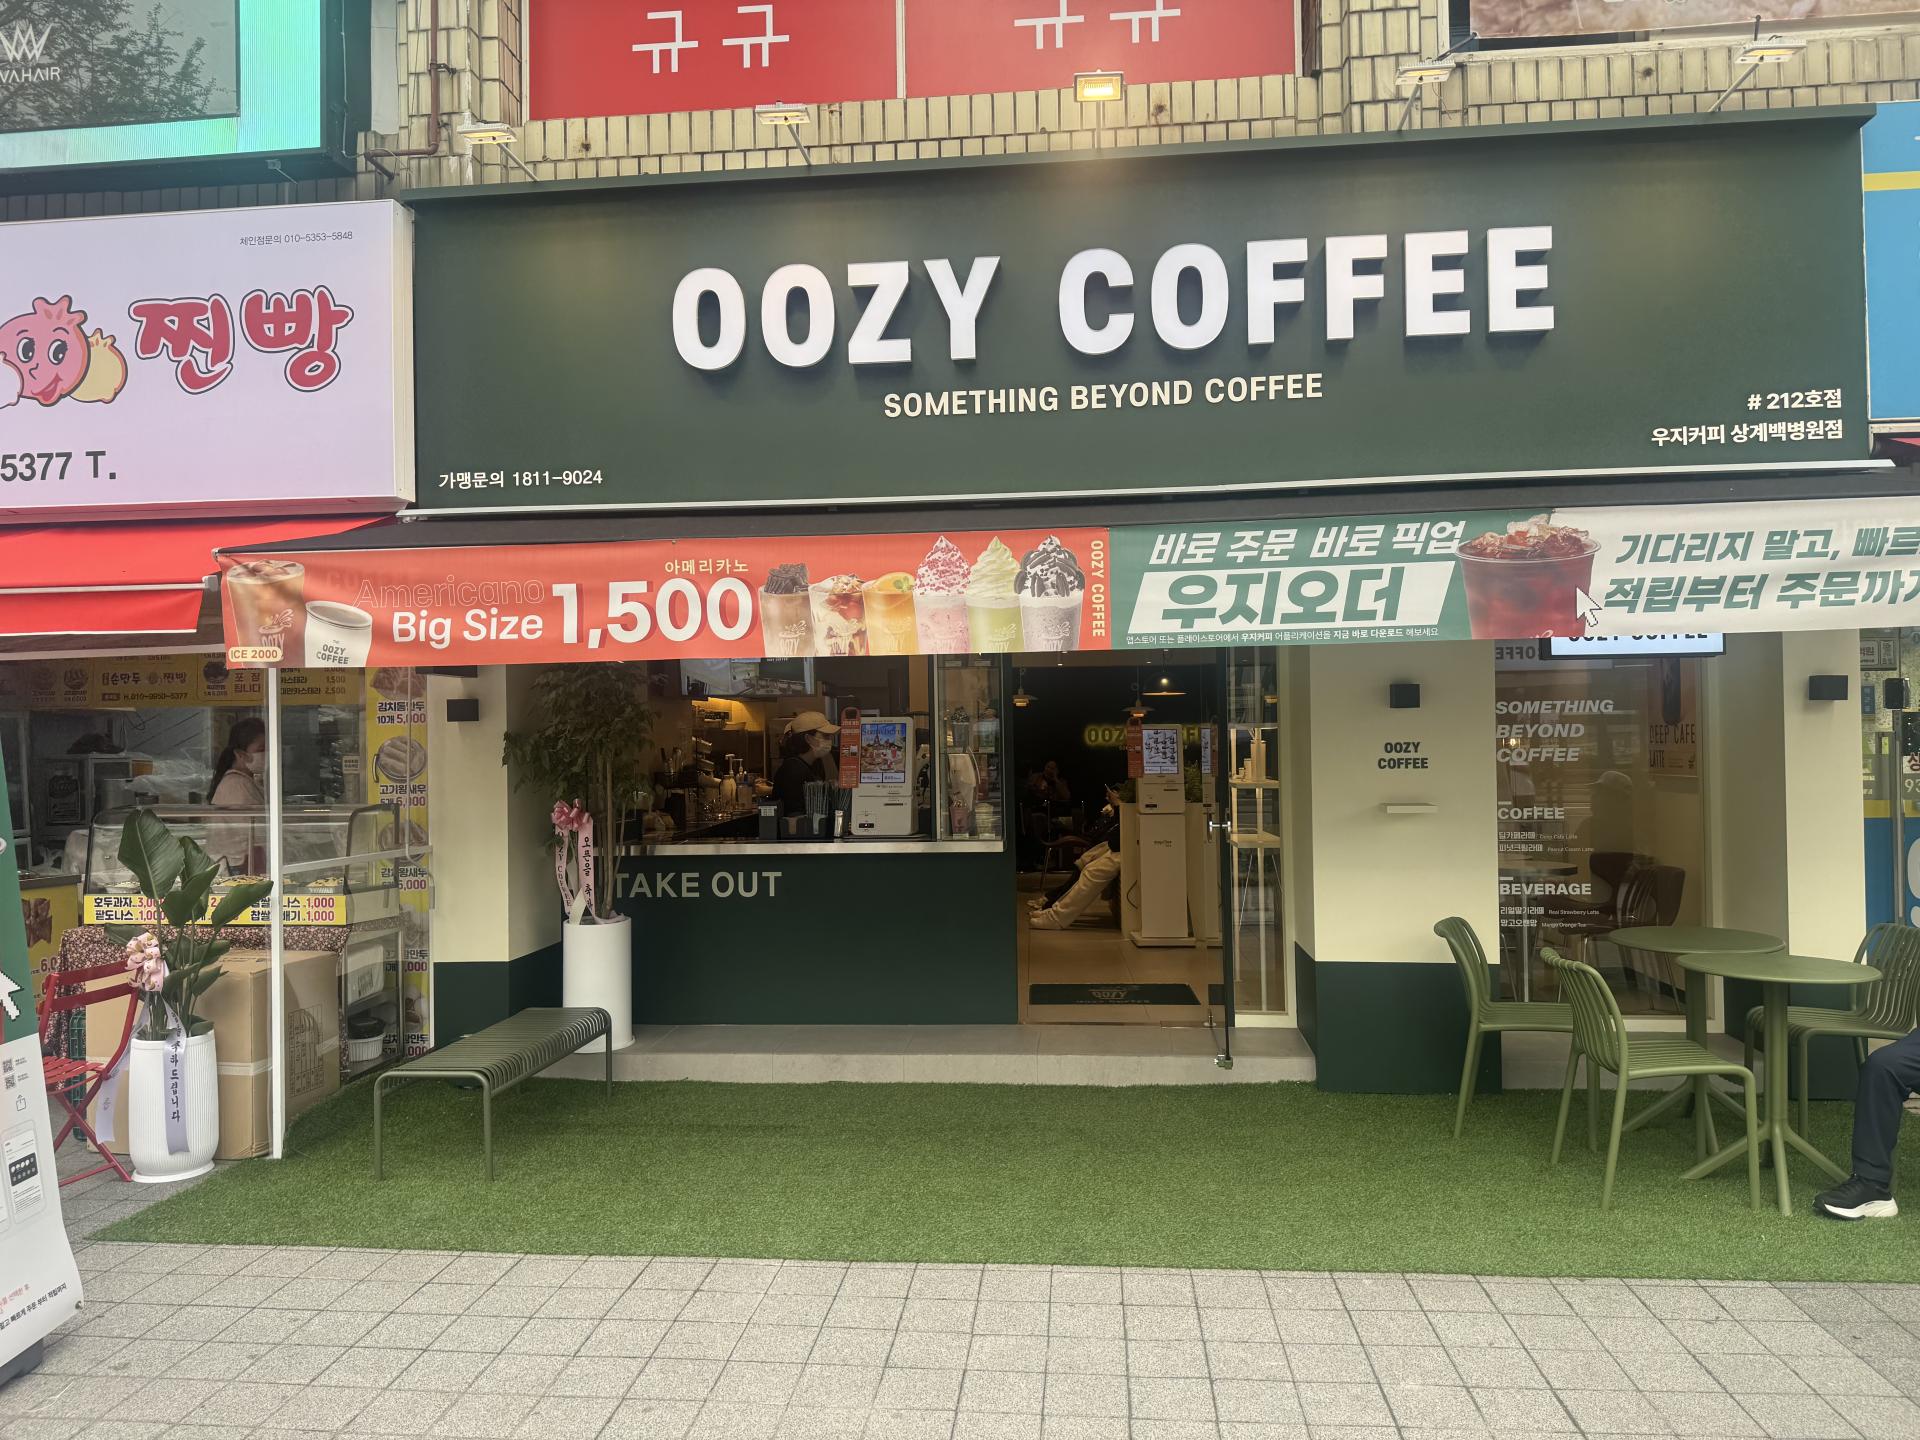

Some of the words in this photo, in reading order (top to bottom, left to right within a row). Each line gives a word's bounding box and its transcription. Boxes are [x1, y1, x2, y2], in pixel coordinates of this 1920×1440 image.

[284, 231, 353, 243] 010-5353-5848
[672, 256, 1001, 371] OOZY
[1058, 225, 1555, 356] COFFEE
[884, 386, 1058, 418] SOMETHING
[1070, 379, 1193, 411] BEYOND
[1204, 372, 1323, 404] COFFEE
[1766, 388, 1842, 410] 212호점
[1651, 424, 1725, 446] 우지커피
[1730, 419, 1843, 442] 상계백병원점
[438, 471, 504, 489] 가맹문의
[512, 469, 603, 487] 1811-9024
[1149, 532, 1221, 565] 바로
[1226, 528, 1297, 563] 주문
[1309, 525, 1385, 558] 바로
[1392, 520, 1466, 555] 픽업
[1614, 531, 1754, 565] 기다리지
[1762, 528, 1839, 563] 말고,
[664, 558, 749, 575] 아메리카노
[1090, 540, 1105, 577] OOZY
[353, 575, 545, 609] Americano
[1161, 566, 1406, 629] 우지오더
[1604, 573, 1769, 614] 적립부터
[392, 610, 452, 649] Big
[463, 608, 543, 641] Size
[551, 577, 753, 648] 1,500
[1092, 583, 1106, 637] COFFEE
[1241, 632, 1273, 642] 우지커피
[1333, 629, 1349, 639] 지금
[1352, 628, 1368, 638] 바로
[1370, 628, 1404, 638] 다운로드
[231, 650, 247, 660] ICE
[251, 650, 278, 660] 2000
[315, 651, 349, 665] COFFEE
[323, 643, 346, 656] OOZY
[1496, 700, 1614, 714] SOMETHING
[1496, 724, 1585, 738] BEYOND
[1384, 741, 1421, 754] OOZY
[1496, 748, 1580, 762] COFFEE
[1377, 757, 1429, 769] COFFEE
[1497, 807, 1565, 820] COFFEE
[615, 872, 700, 898] TAKE
[711, 871, 783, 898] OUT
[1499, 883, 1592, 895] BEVERAGE
